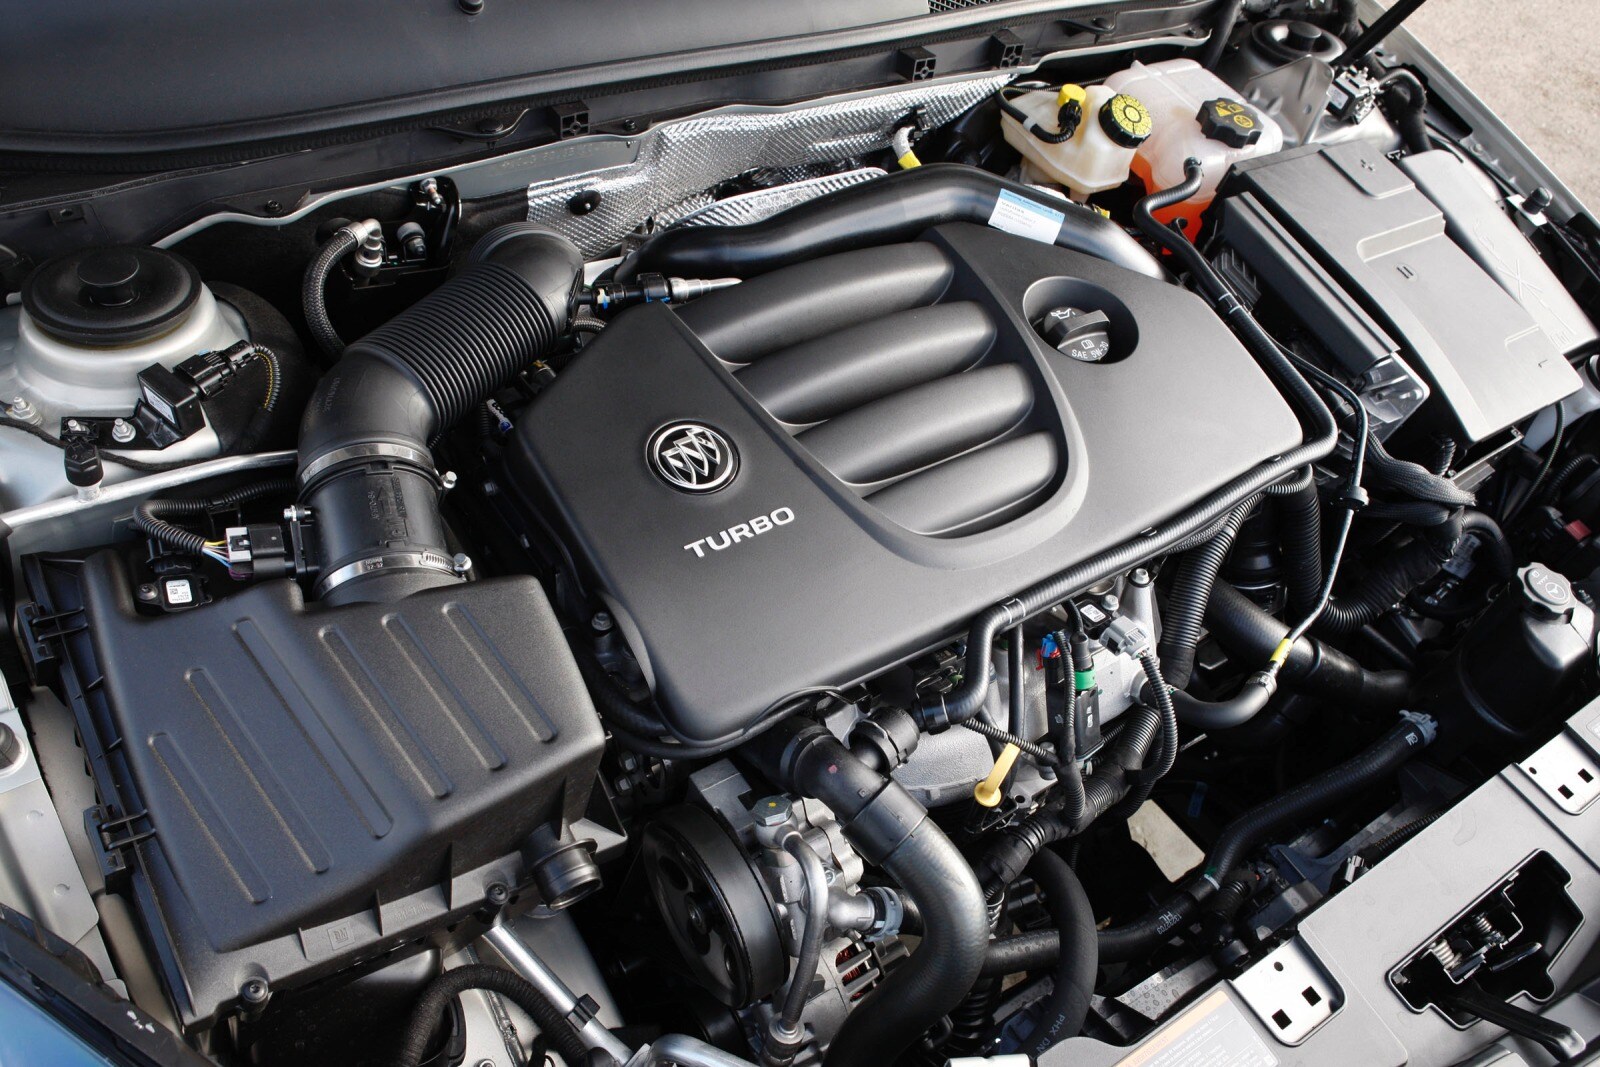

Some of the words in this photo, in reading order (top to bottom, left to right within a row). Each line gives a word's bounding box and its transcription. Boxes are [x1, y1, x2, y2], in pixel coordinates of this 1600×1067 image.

[1071, 349, 1088, 359] SAE
[1091, 341, 1108, 358] 5W-30
[683, 506, 795, 558] TURBO
[1405, 732, 1418, 745] GM
[1049, 1014, 1066, 1036] PHX
[1036, 1037, 1051, 1054] DN
